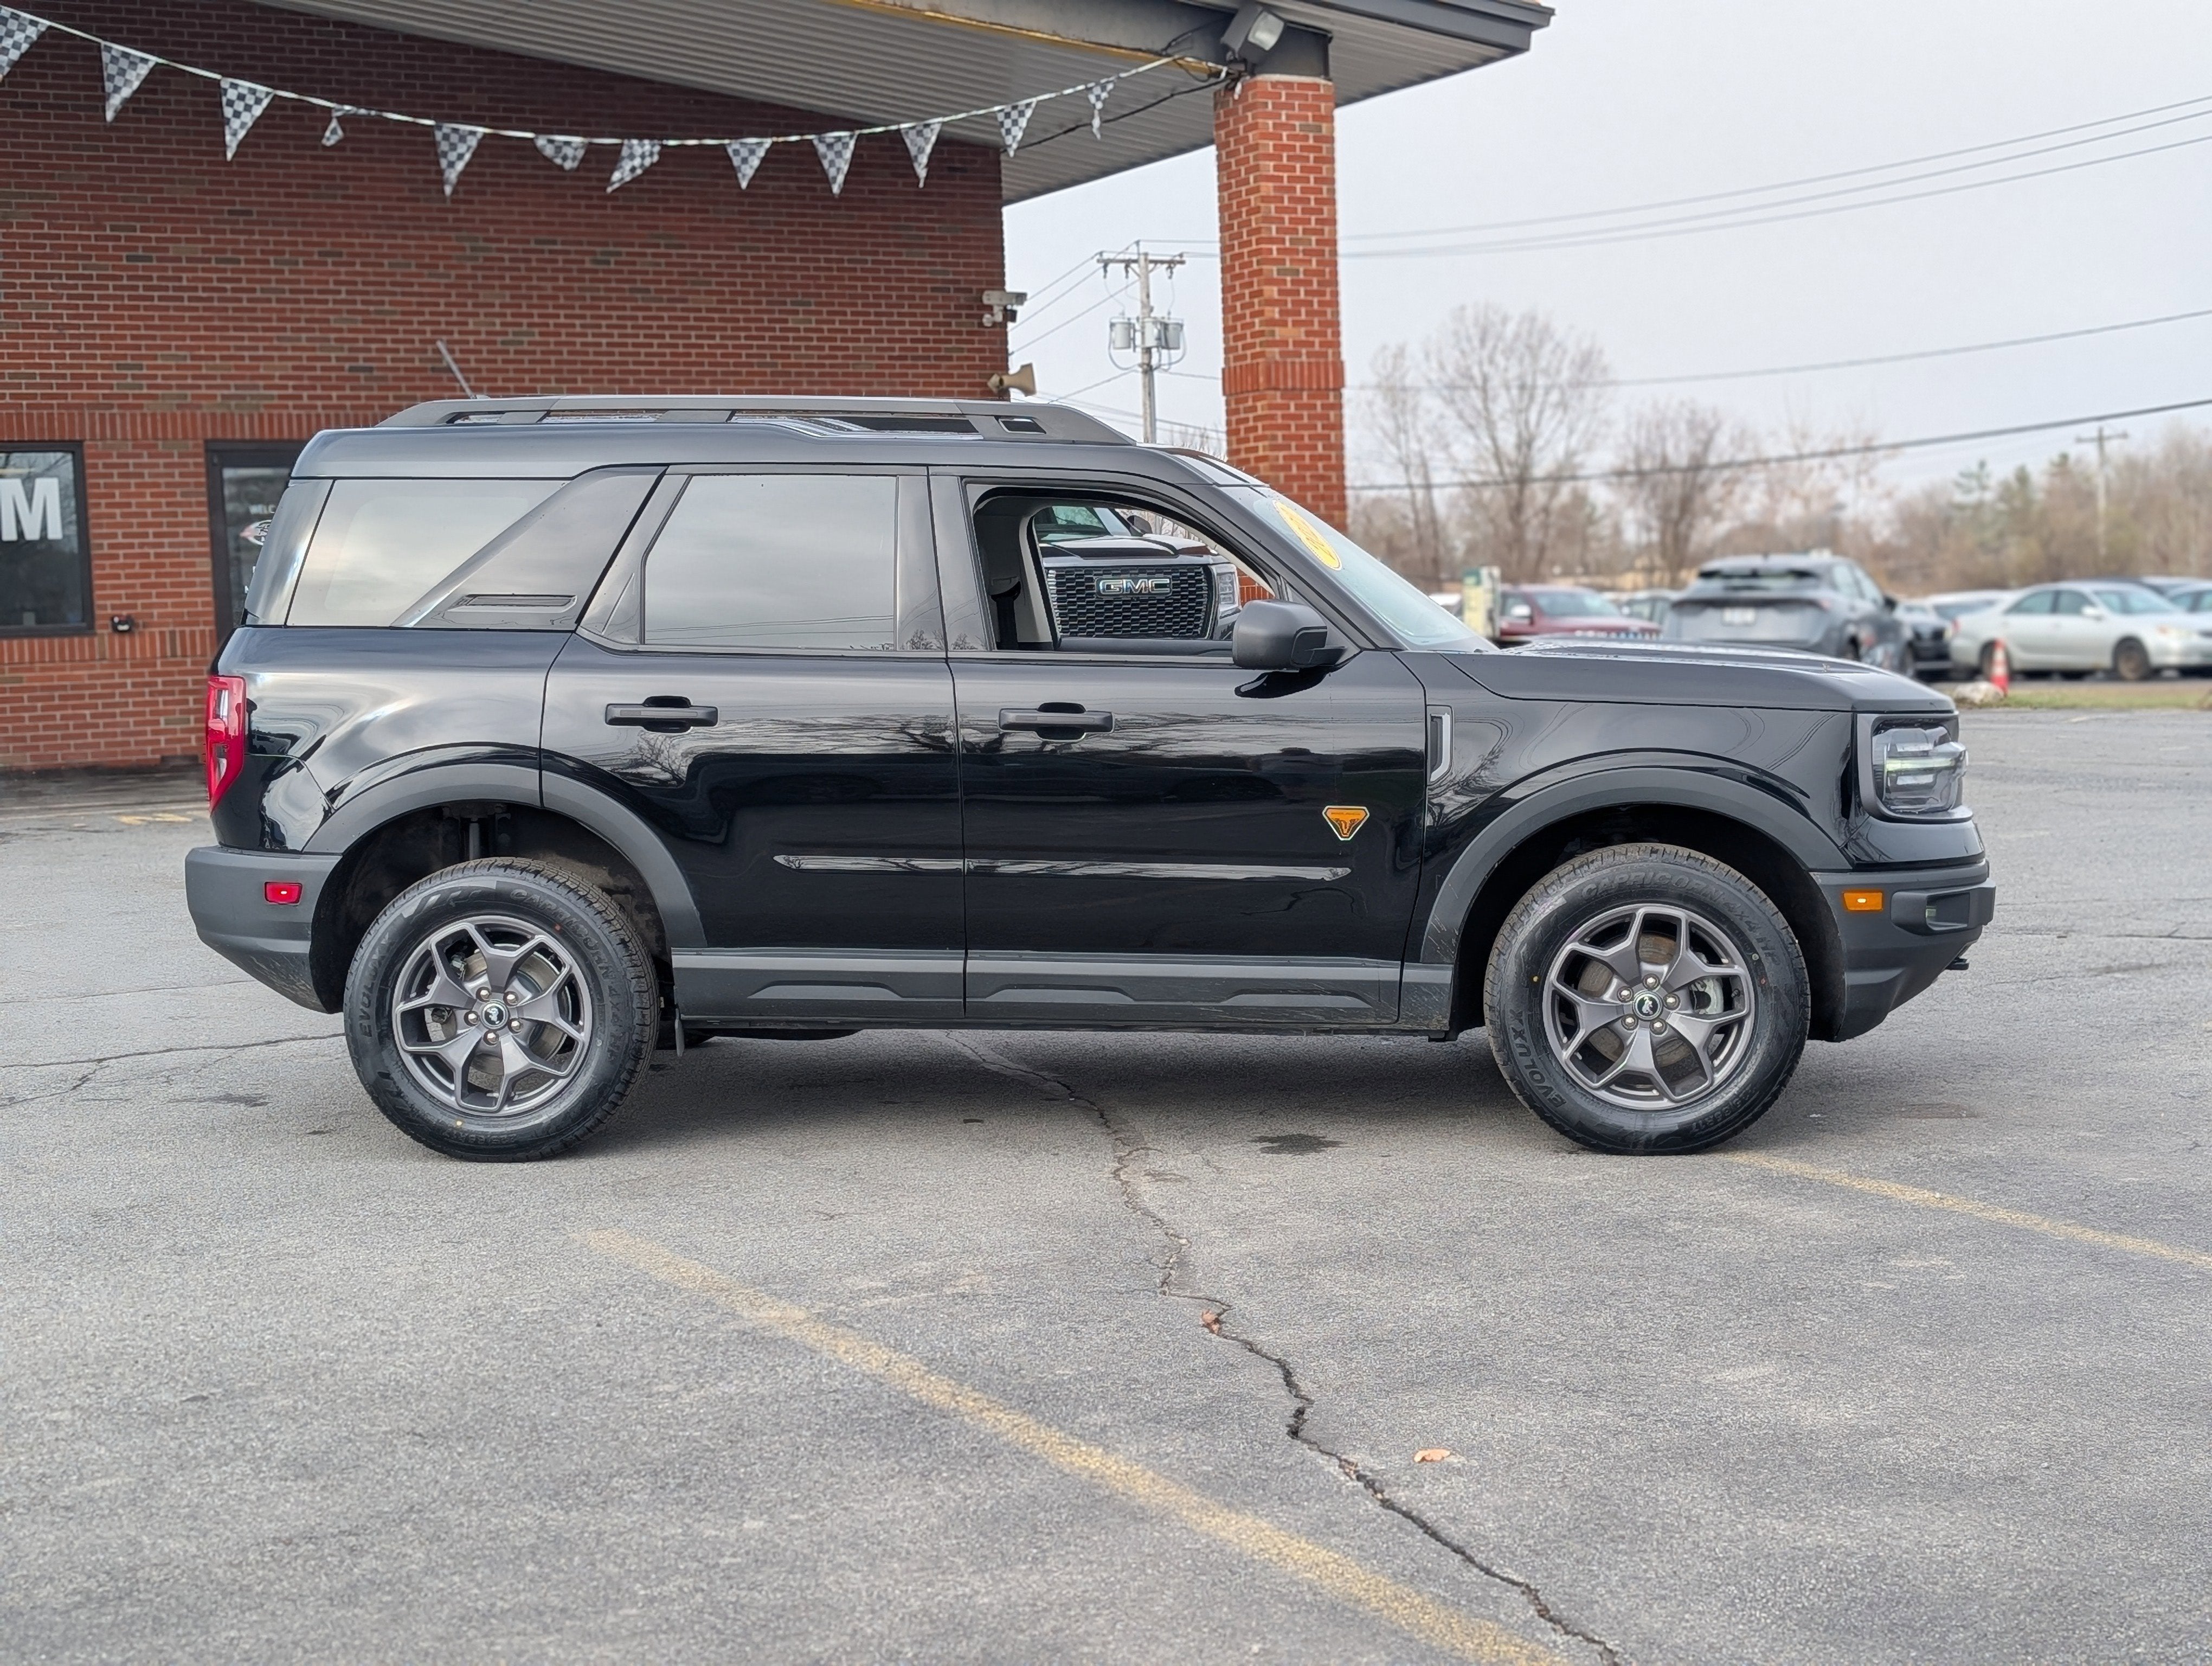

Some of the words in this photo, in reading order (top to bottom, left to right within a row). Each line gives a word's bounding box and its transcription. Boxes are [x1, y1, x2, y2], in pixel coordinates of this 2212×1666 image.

[1099, 579, 1170, 594] GMC
[1581, 870, 1724, 902] CAPRICORN
[511, 889, 614, 977] CAPRICORN
[1509, 1009, 1567, 1107] EVOLUXX
